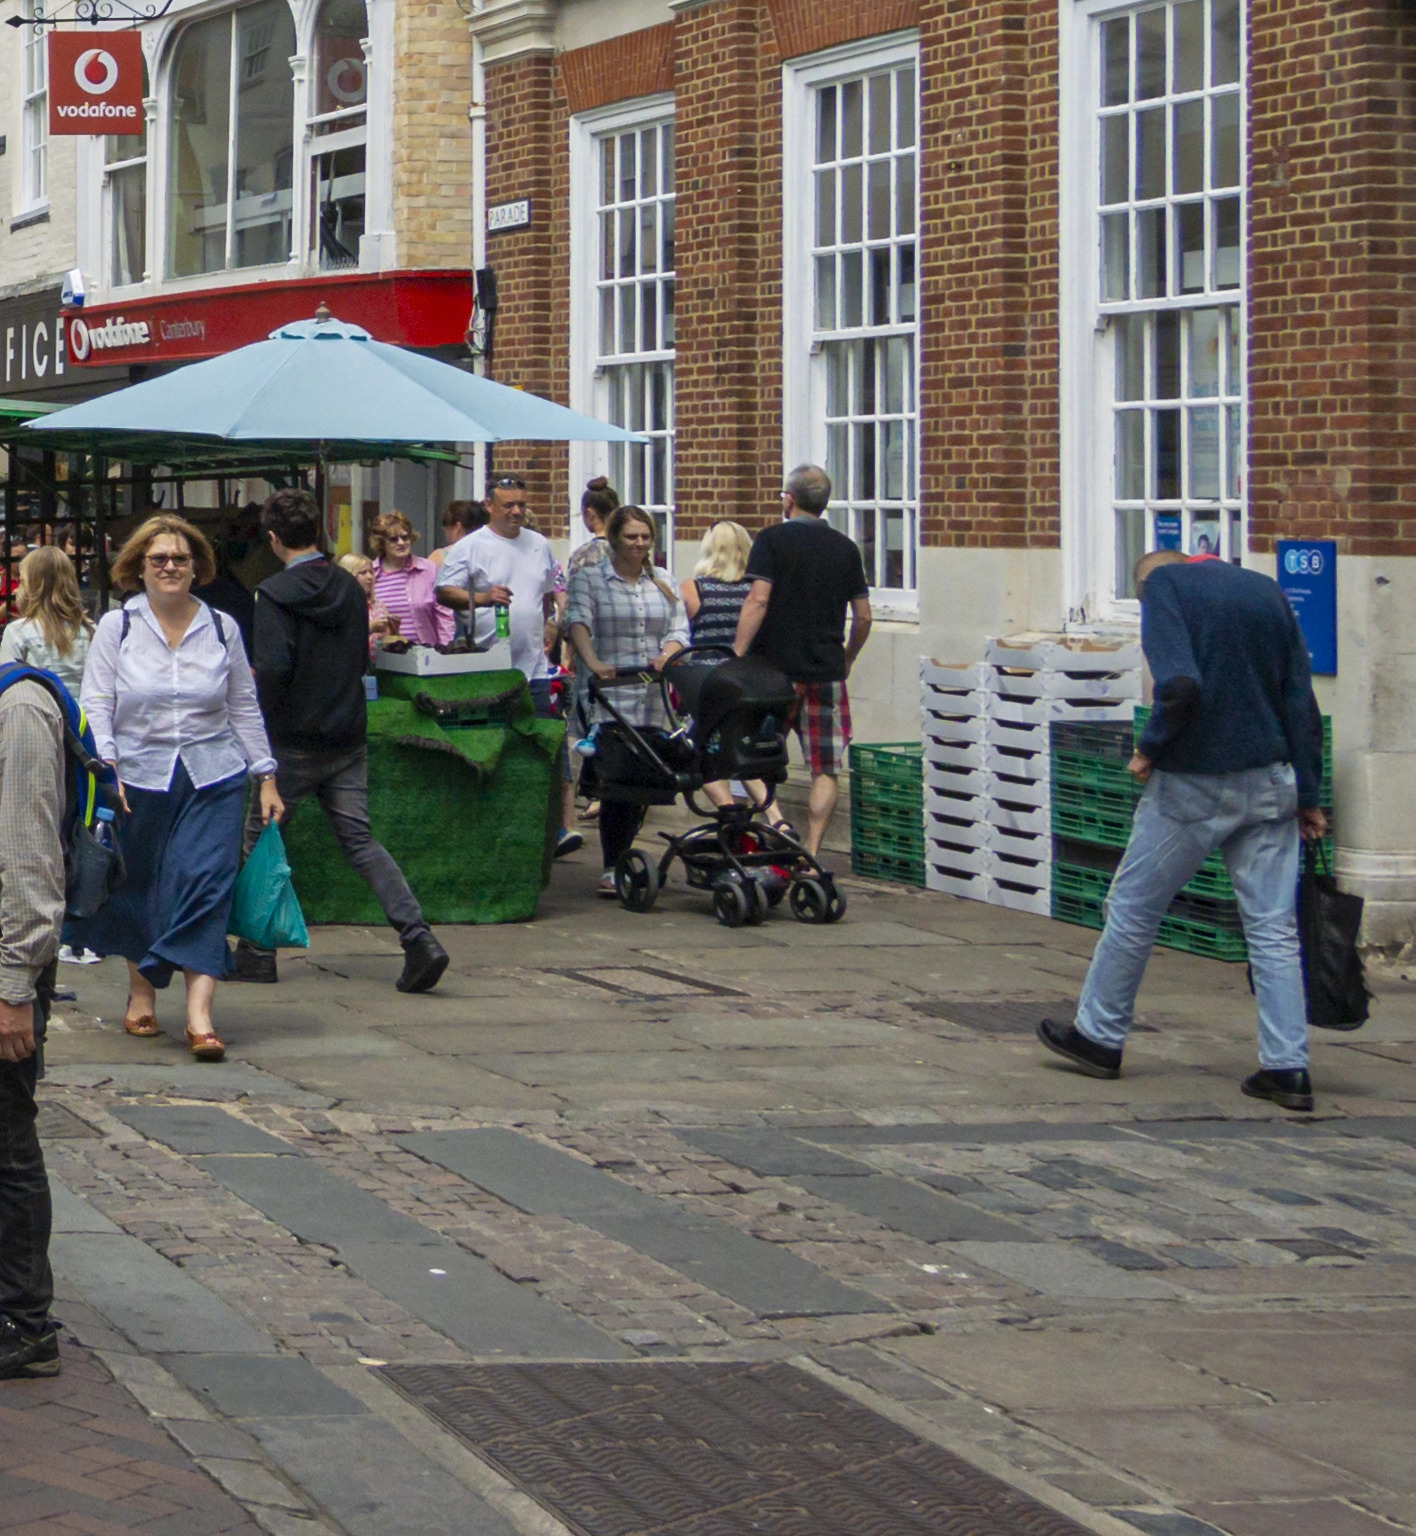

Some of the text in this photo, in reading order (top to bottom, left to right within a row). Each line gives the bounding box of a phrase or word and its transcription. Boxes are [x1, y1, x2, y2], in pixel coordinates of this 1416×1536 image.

[56, 100, 138, 119] vodafone
[489, 203, 526, 227] PARADE
[89, 315, 205, 349] vodafone Canterbury
[1288, 554, 1320, 569] TSB
